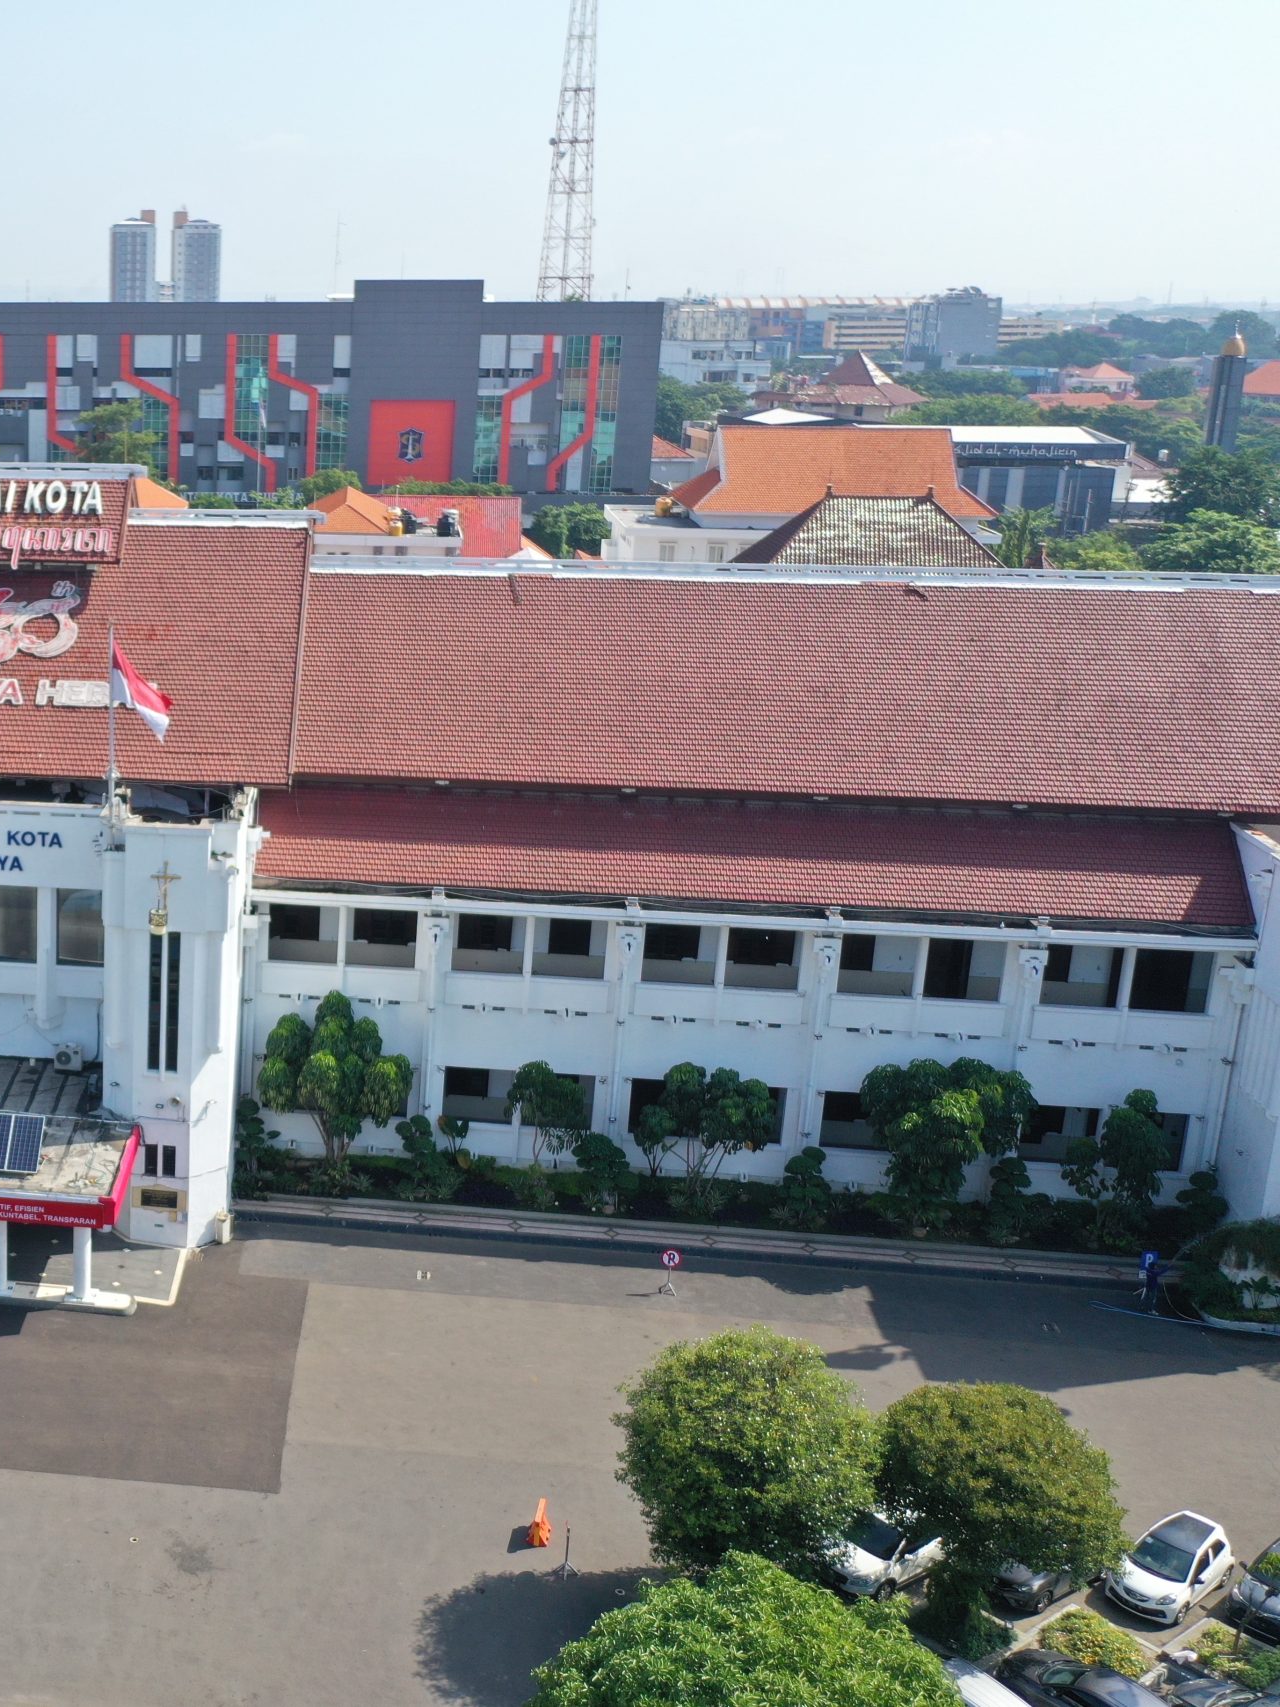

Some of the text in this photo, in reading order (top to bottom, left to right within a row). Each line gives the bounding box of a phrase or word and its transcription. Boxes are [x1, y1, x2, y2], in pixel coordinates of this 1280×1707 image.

[23, 480, 103, 515] KOTA
[36, 679, 157, 708] HEB
[7, 831, 63, 848] KOTA
[15, 1205, 45, 1213] EFISIEN
[43, 1214, 97, 1225] TRANSPARAN
[1145, 1253, 1154, 1268] P
